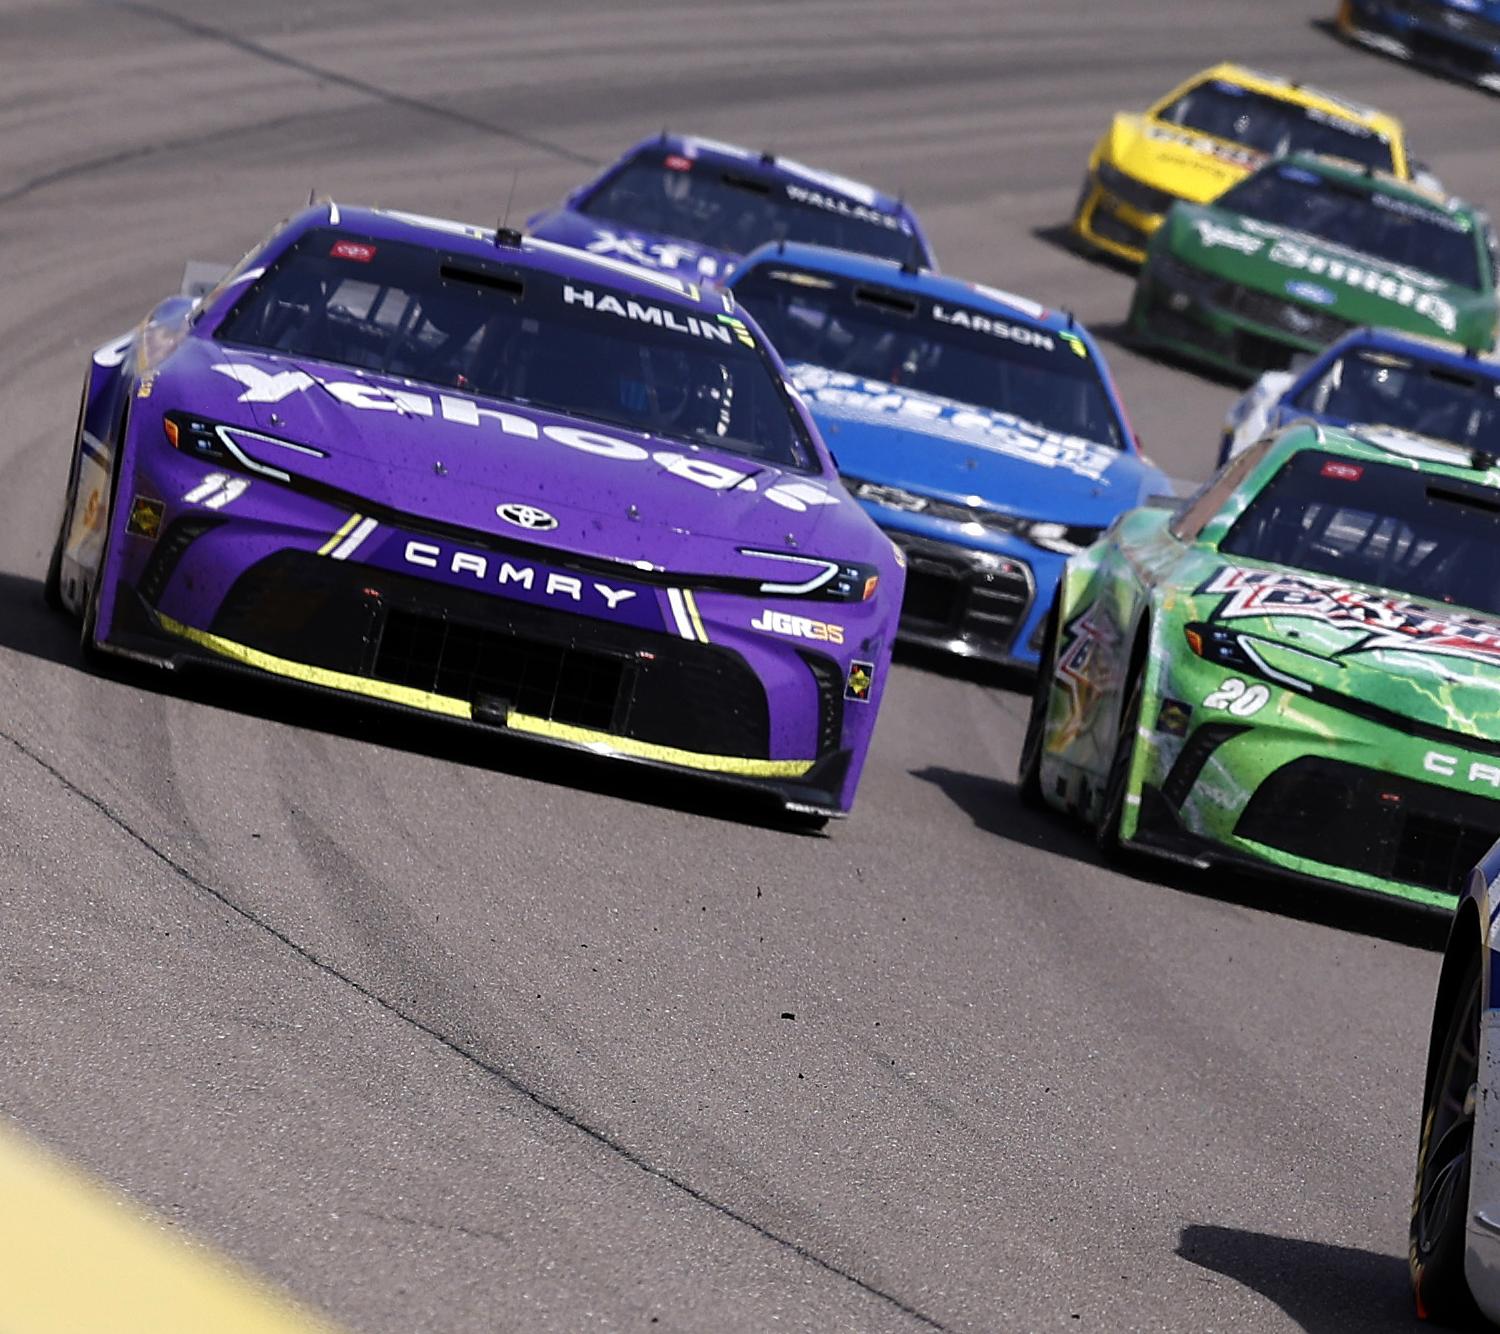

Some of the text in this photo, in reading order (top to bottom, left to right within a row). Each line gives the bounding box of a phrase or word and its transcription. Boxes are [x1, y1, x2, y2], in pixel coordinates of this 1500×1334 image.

[785, 185, 899, 231] WALLACE
[563, 284, 732, 345] HAMLIN
[932, 304, 1056, 352] LARSON
[182, 471, 252, 510] 11
[403, 541, 637, 611] CAMRY
[1203, 677, 1272, 717] 20
